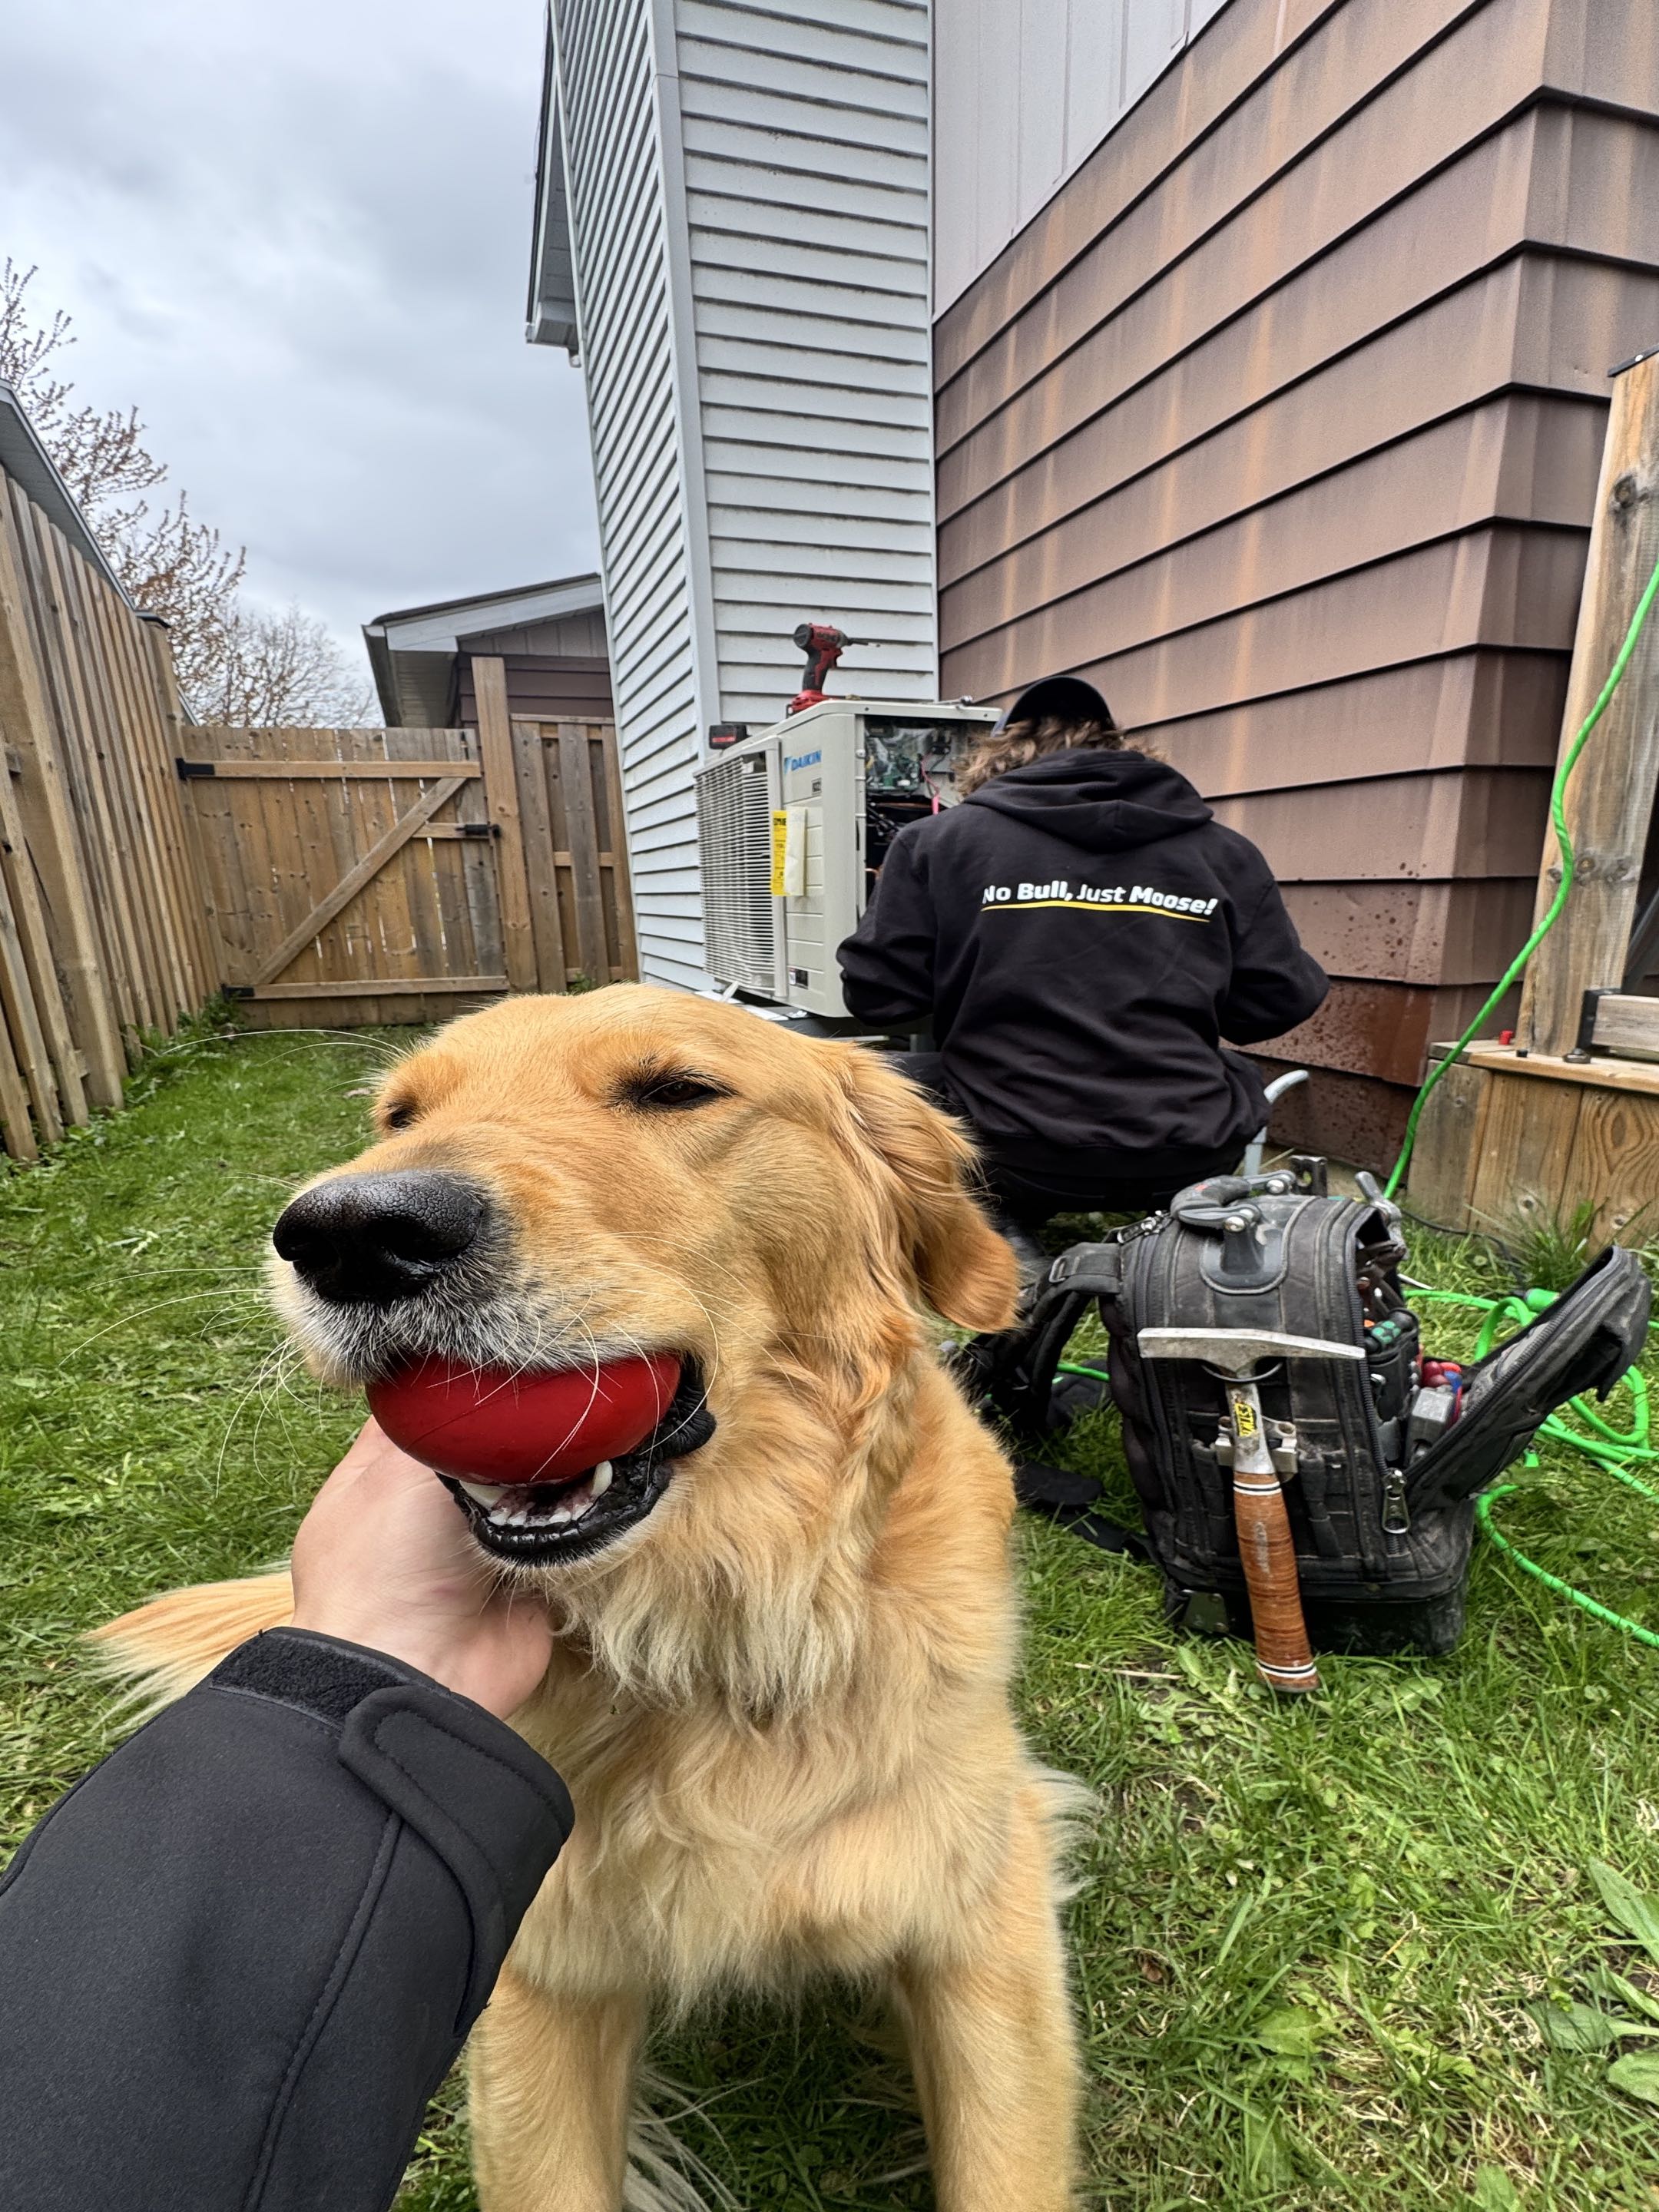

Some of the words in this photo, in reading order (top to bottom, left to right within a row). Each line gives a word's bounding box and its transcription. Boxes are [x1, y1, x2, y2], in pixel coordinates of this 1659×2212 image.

[791, 750, 822, 771] DAIKIN
[982, 885, 1012, 904] No
[1017, 880, 1074, 901] Bull,
[1076, 884, 1127, 902] Just
[1129, 886, 1218, 916] Moose!
